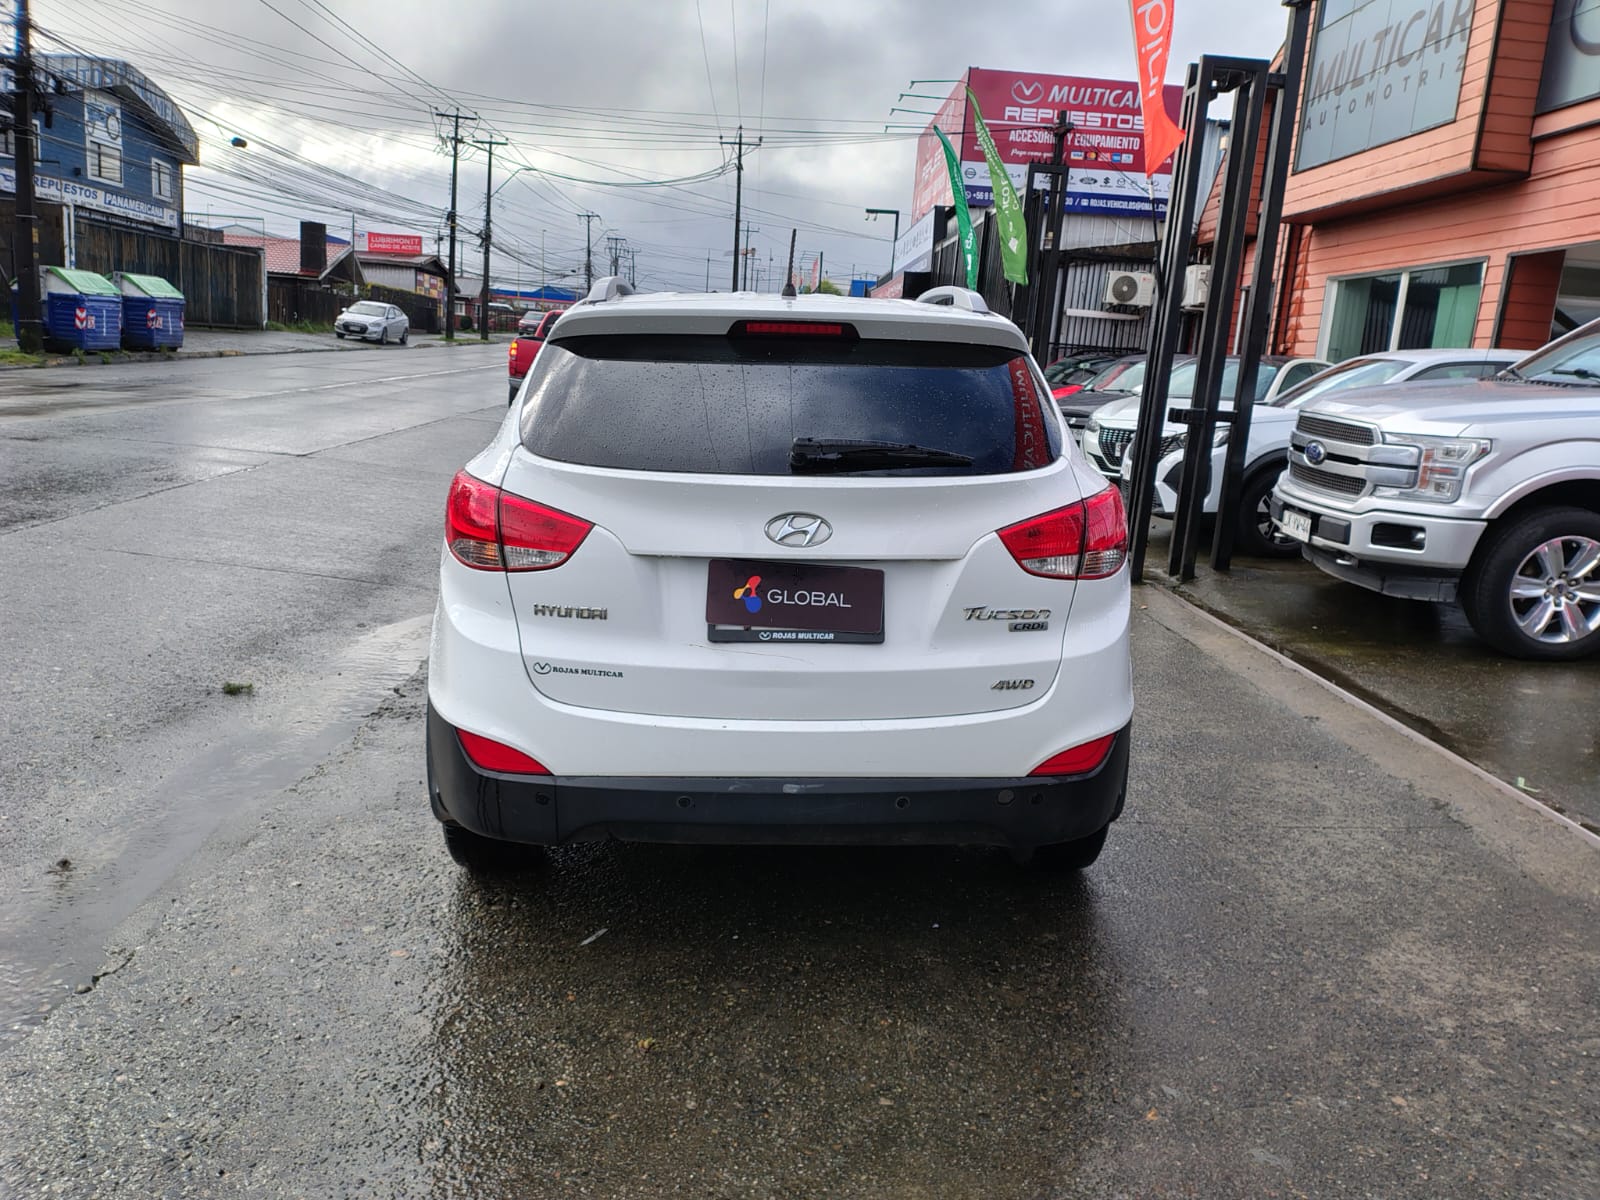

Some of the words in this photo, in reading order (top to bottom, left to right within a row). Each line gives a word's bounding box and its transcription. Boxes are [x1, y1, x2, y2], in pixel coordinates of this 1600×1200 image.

[1309, 0, 1474, 108] MULTICAR
[1305, 54, 1466, 132] AUTOMOTRIZ
[1009, 129, 1057, 144] ACCESORI
[1074, 133, 1140, 150] EQUIPAMIENTO
[33, 175, 98, 199] REPUESTOS
[105, 192, 164, 217] PANAMERICANA
[767, 589, 852, 608] GLOBAL
[533, 602, 608, 620] HYUNDAI
[1013, 622, 1045, 631] CRDi
[772, 632, 796, 640] ROJAS
[798, 632, 835, 640] MULTICAR
[552, 666, 579, 675] ROJAS
[580, 668, 624, 678] MULTICAR
[990, 679, 1035, 690] 4WD
